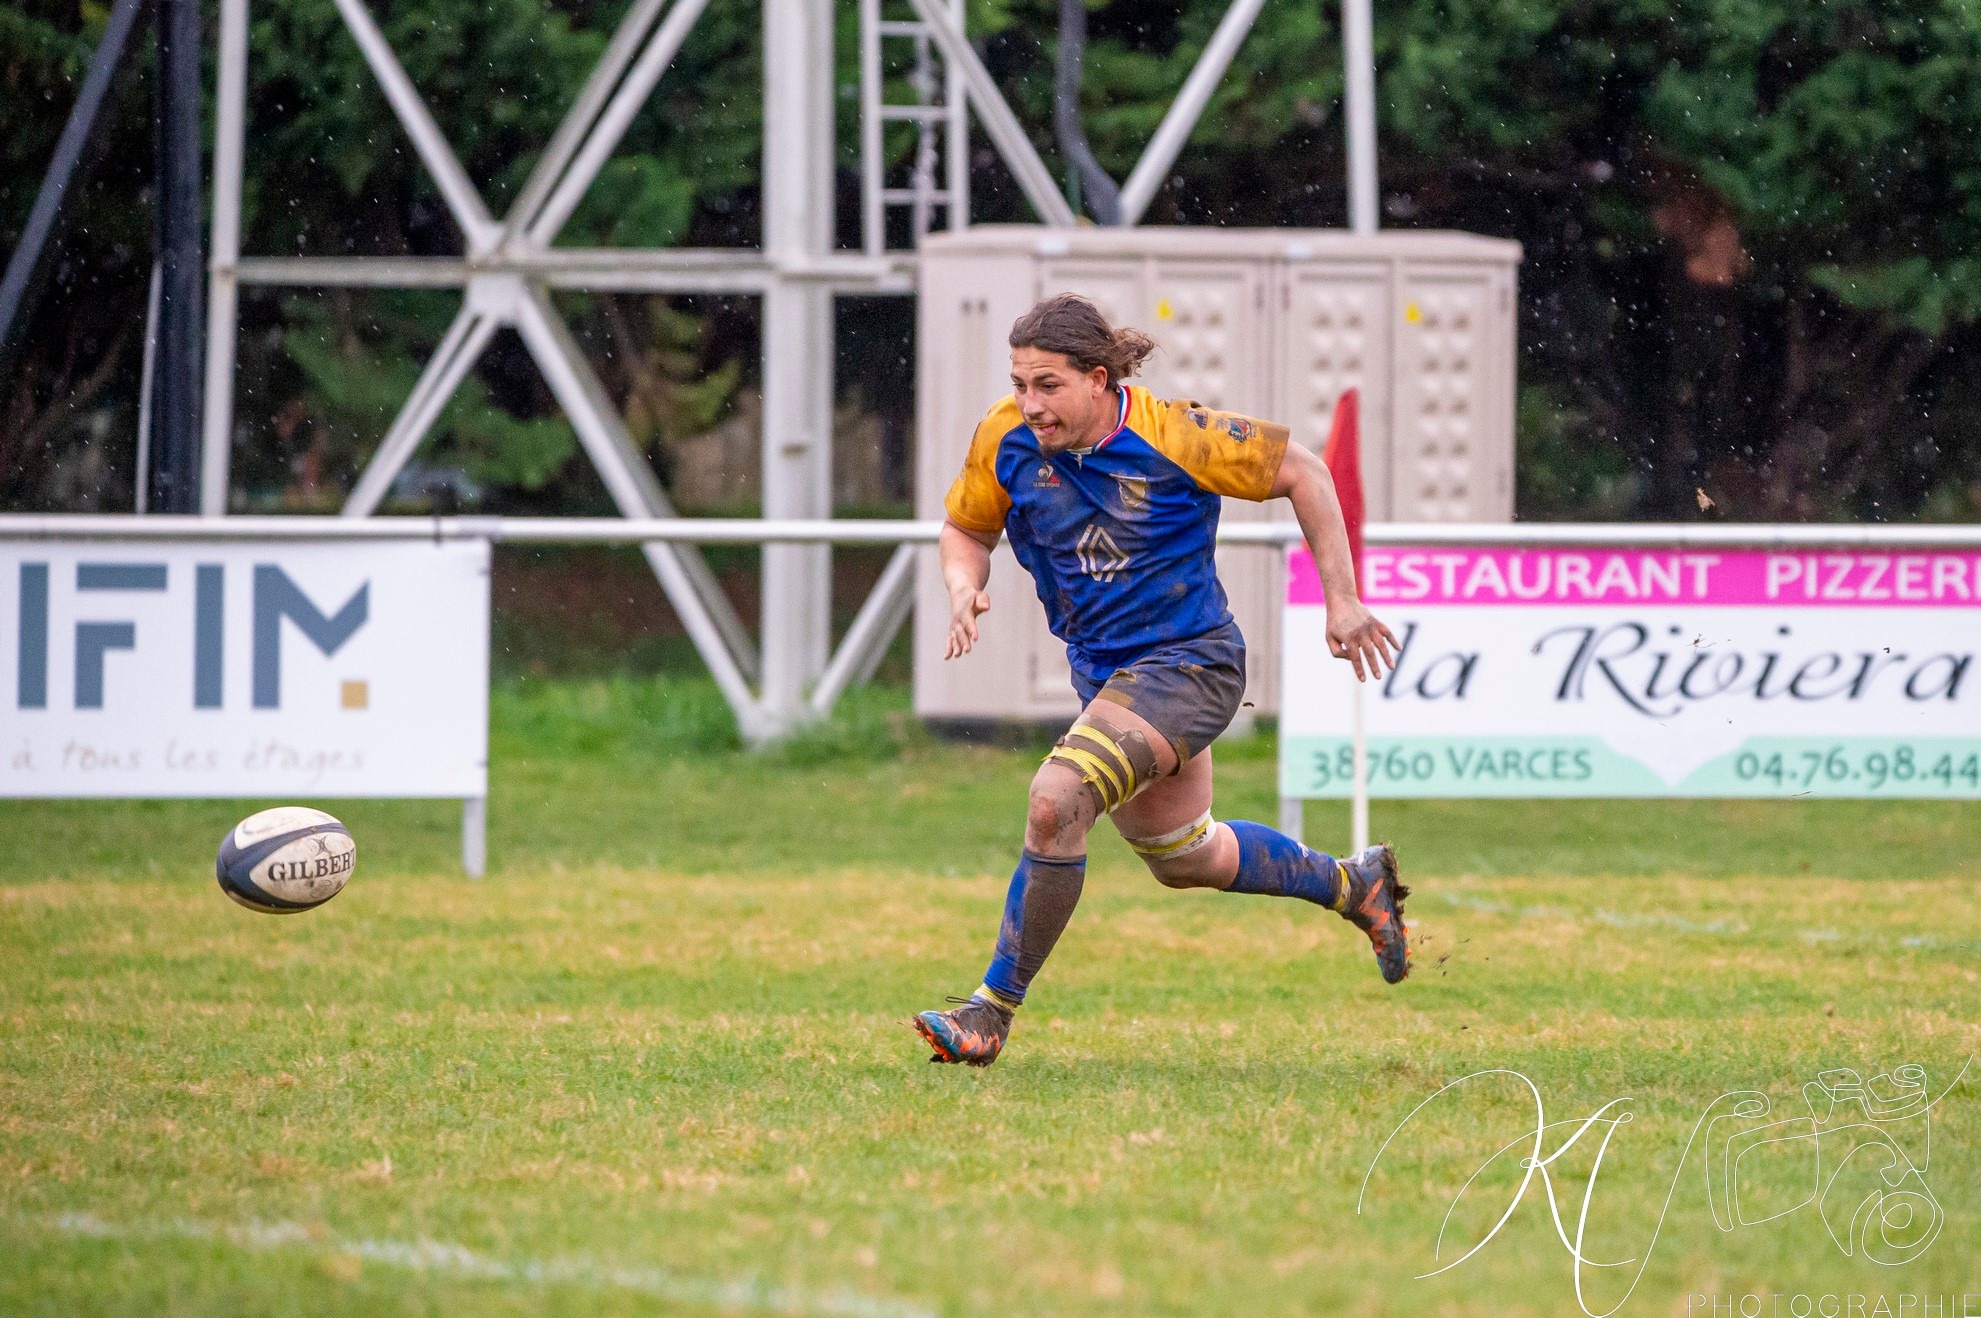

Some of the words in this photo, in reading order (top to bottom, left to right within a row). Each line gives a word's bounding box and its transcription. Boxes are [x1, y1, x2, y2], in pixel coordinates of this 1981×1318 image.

[1364, 554, 1721, 599] ESTAURANT
[1382, 620, 1481, 700] la
[1530, 620, 1973, 719] Riviera
[1447, 747, 1593, 781] VARCES
